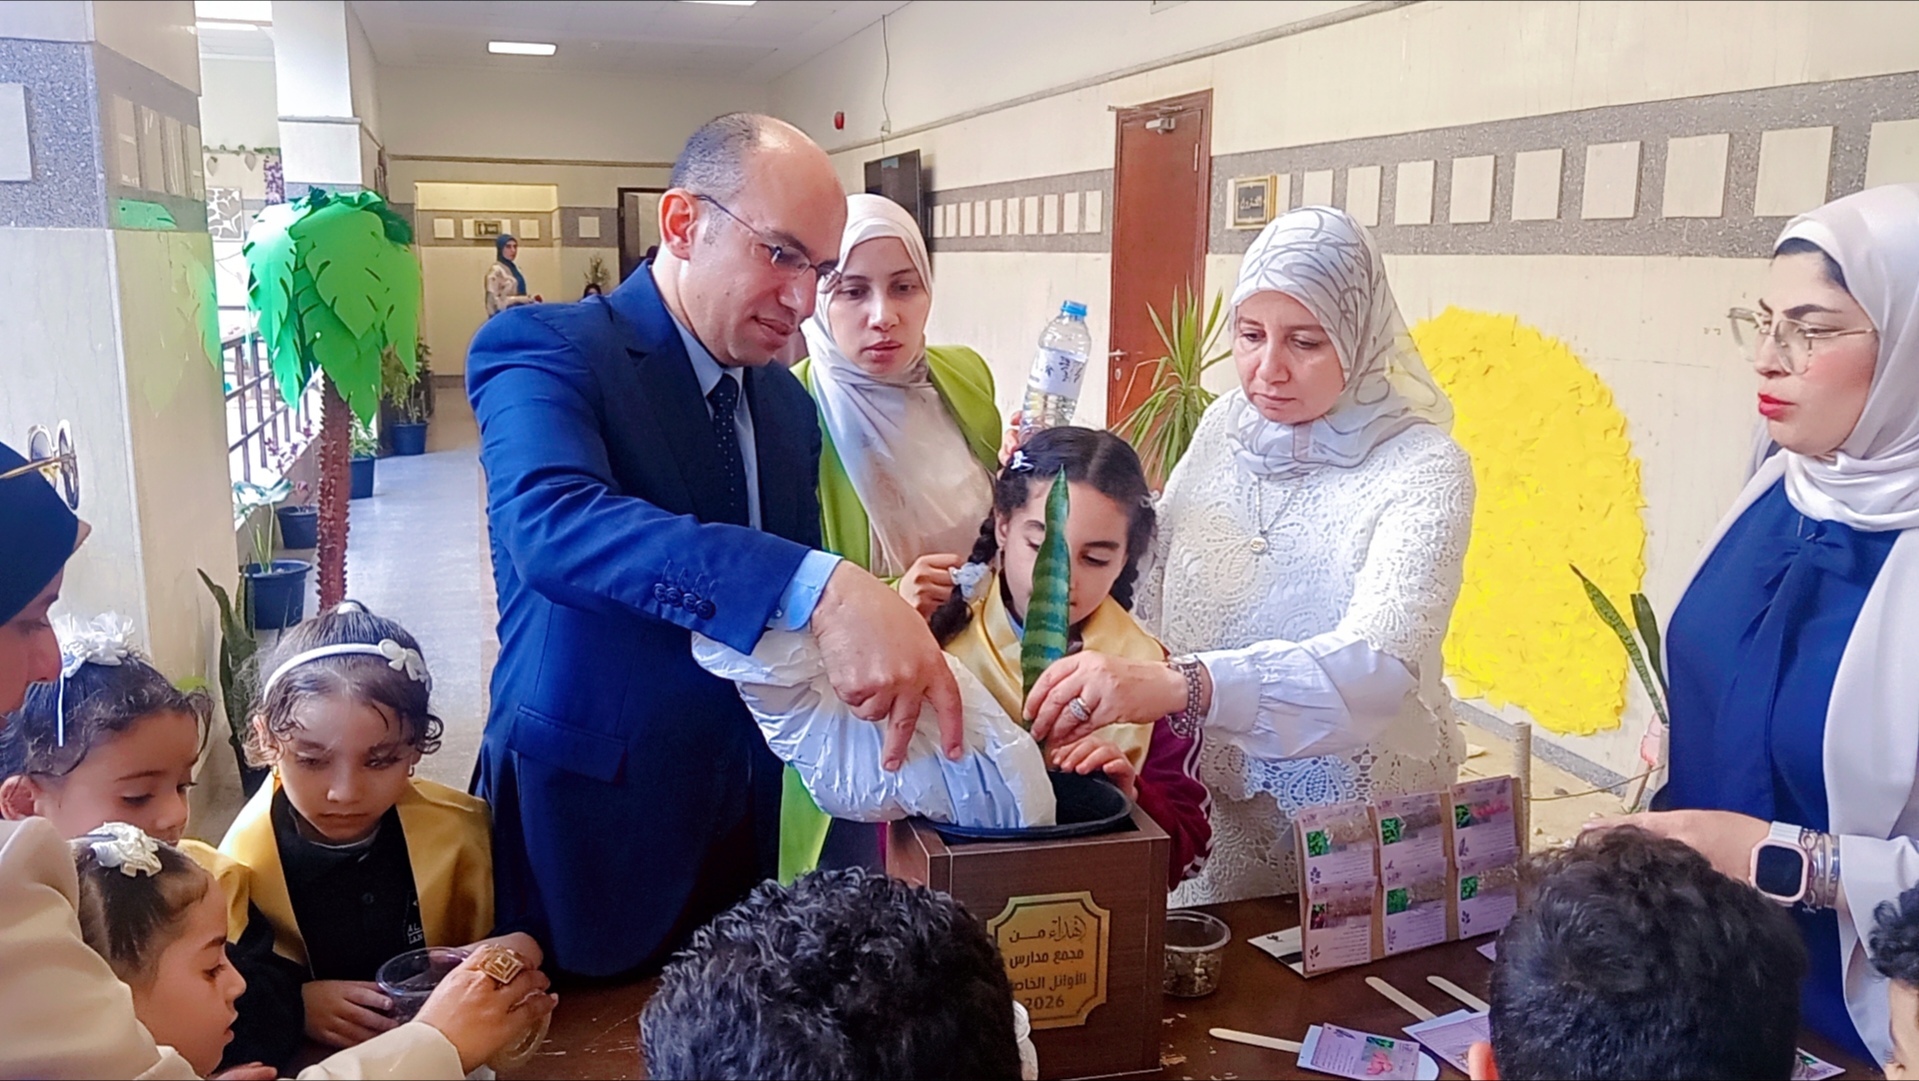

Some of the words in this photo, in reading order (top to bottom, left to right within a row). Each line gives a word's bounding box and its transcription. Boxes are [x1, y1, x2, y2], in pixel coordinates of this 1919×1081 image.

[1009, 928, 1046, 943] من
[1009, 951, 1049, 969] مدارس
[1053, 948, 1085, 965] مجمع
[1012, 976, 1046, 991] الخاص
[1048, 970, 1087, 991] الأوائل
[1024, 993, 1065, 1011] 2026
